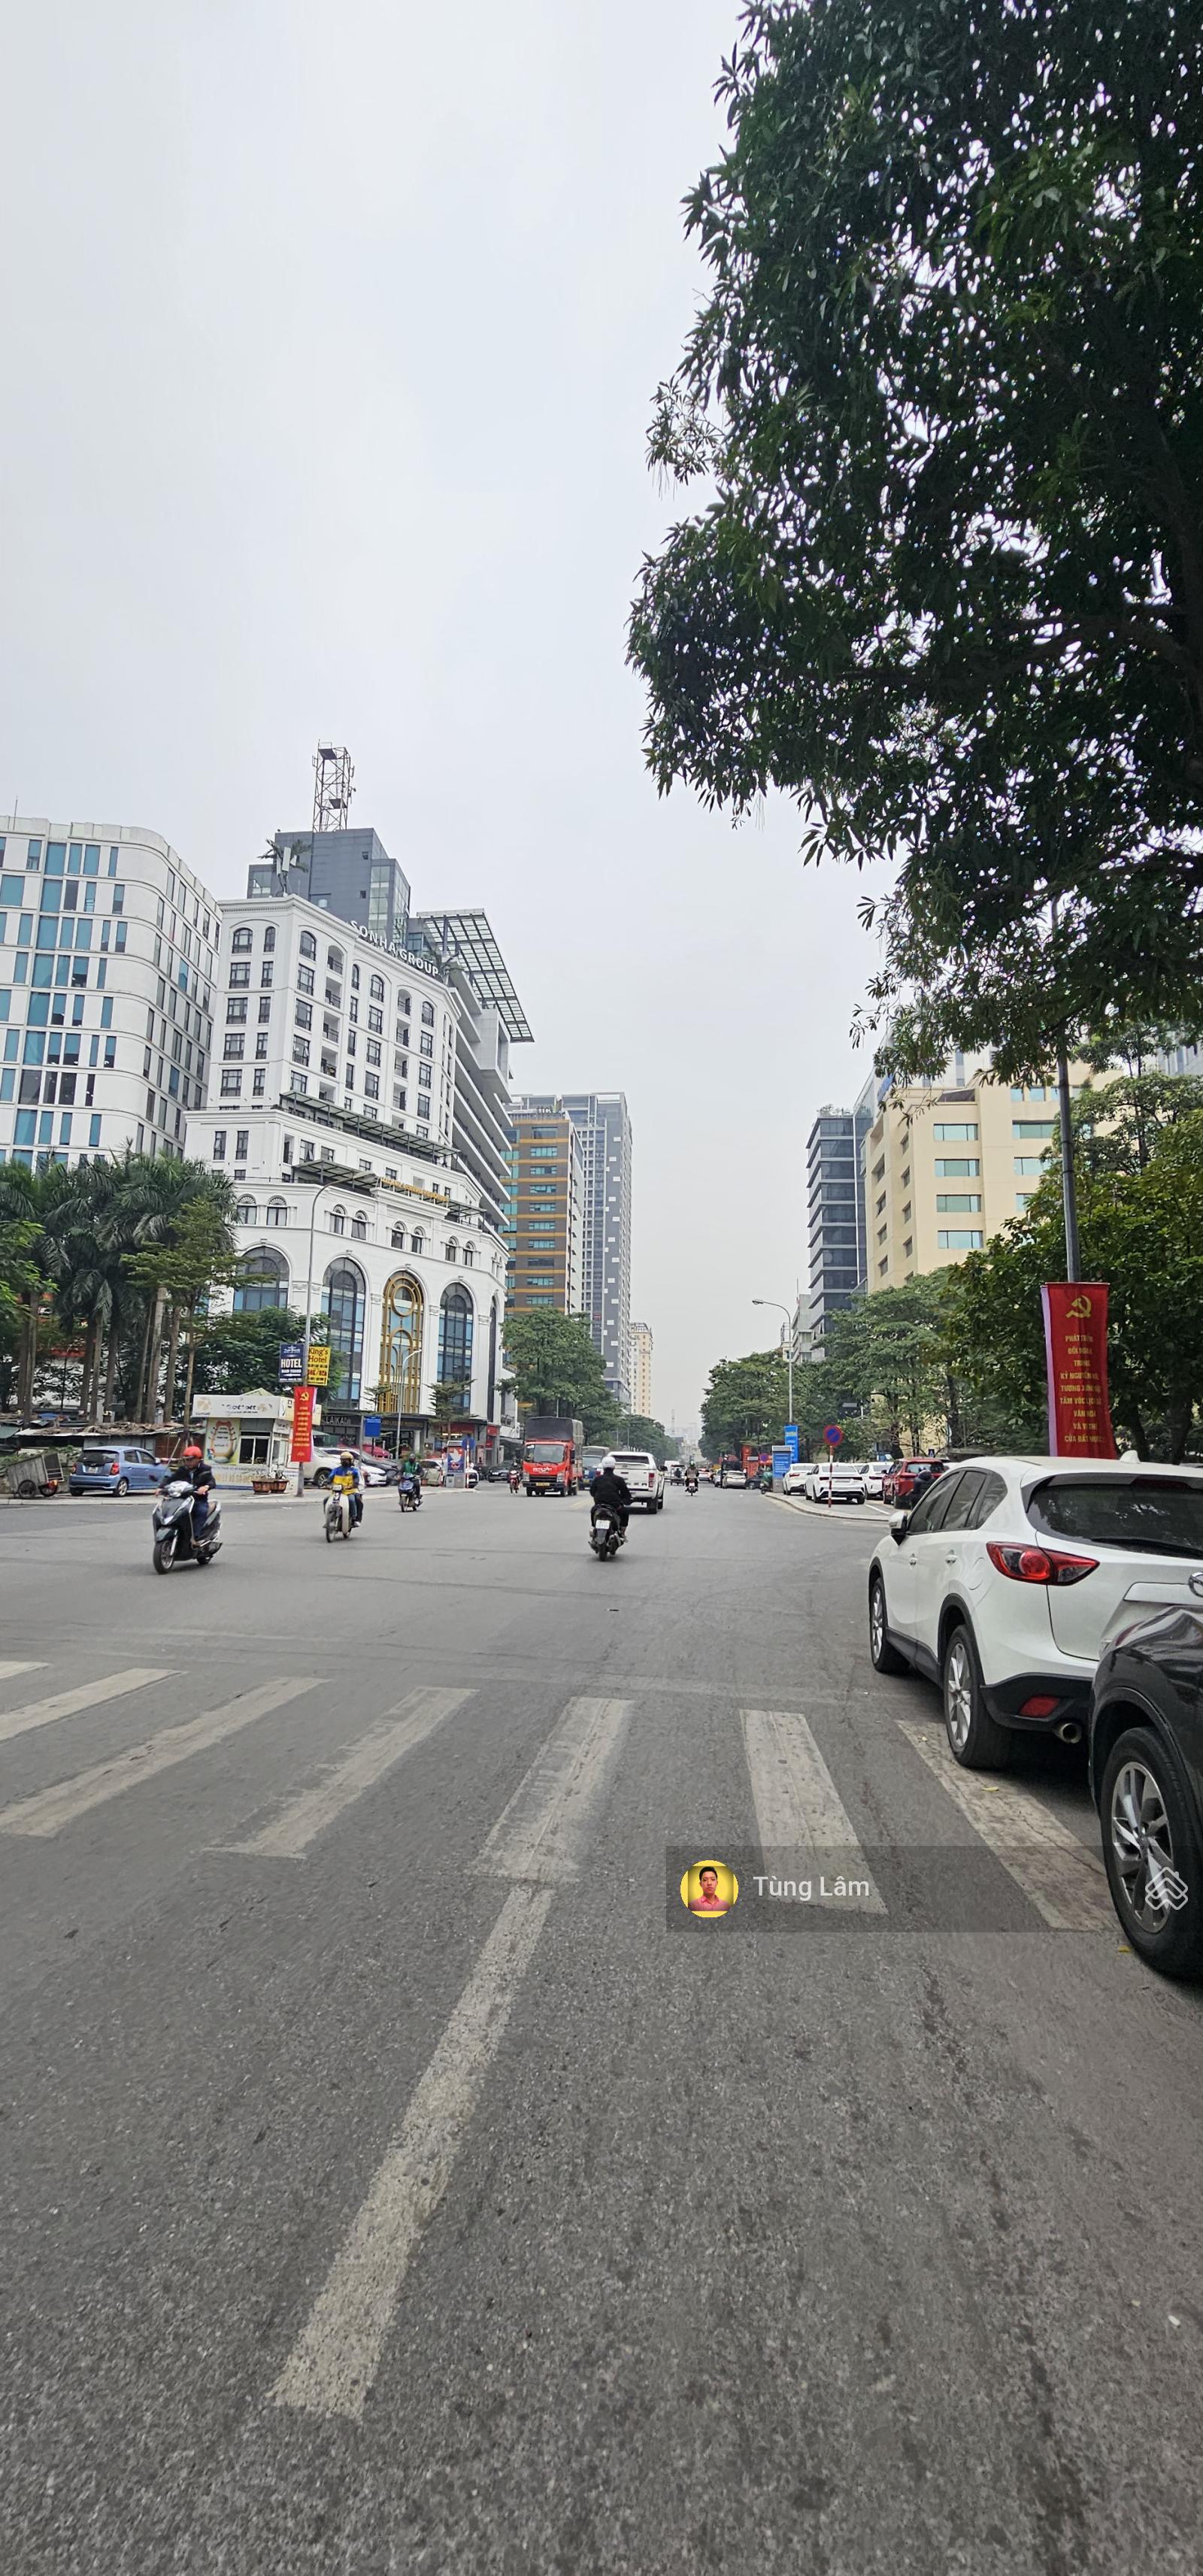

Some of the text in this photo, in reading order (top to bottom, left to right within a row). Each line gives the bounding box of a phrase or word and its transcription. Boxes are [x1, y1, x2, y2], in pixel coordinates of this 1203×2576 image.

[350, 920, 438, 976] SONHA GROUP
[309, 1348, 328, 1356] King's
[280, 1359, 302, 1368] HOTEL
